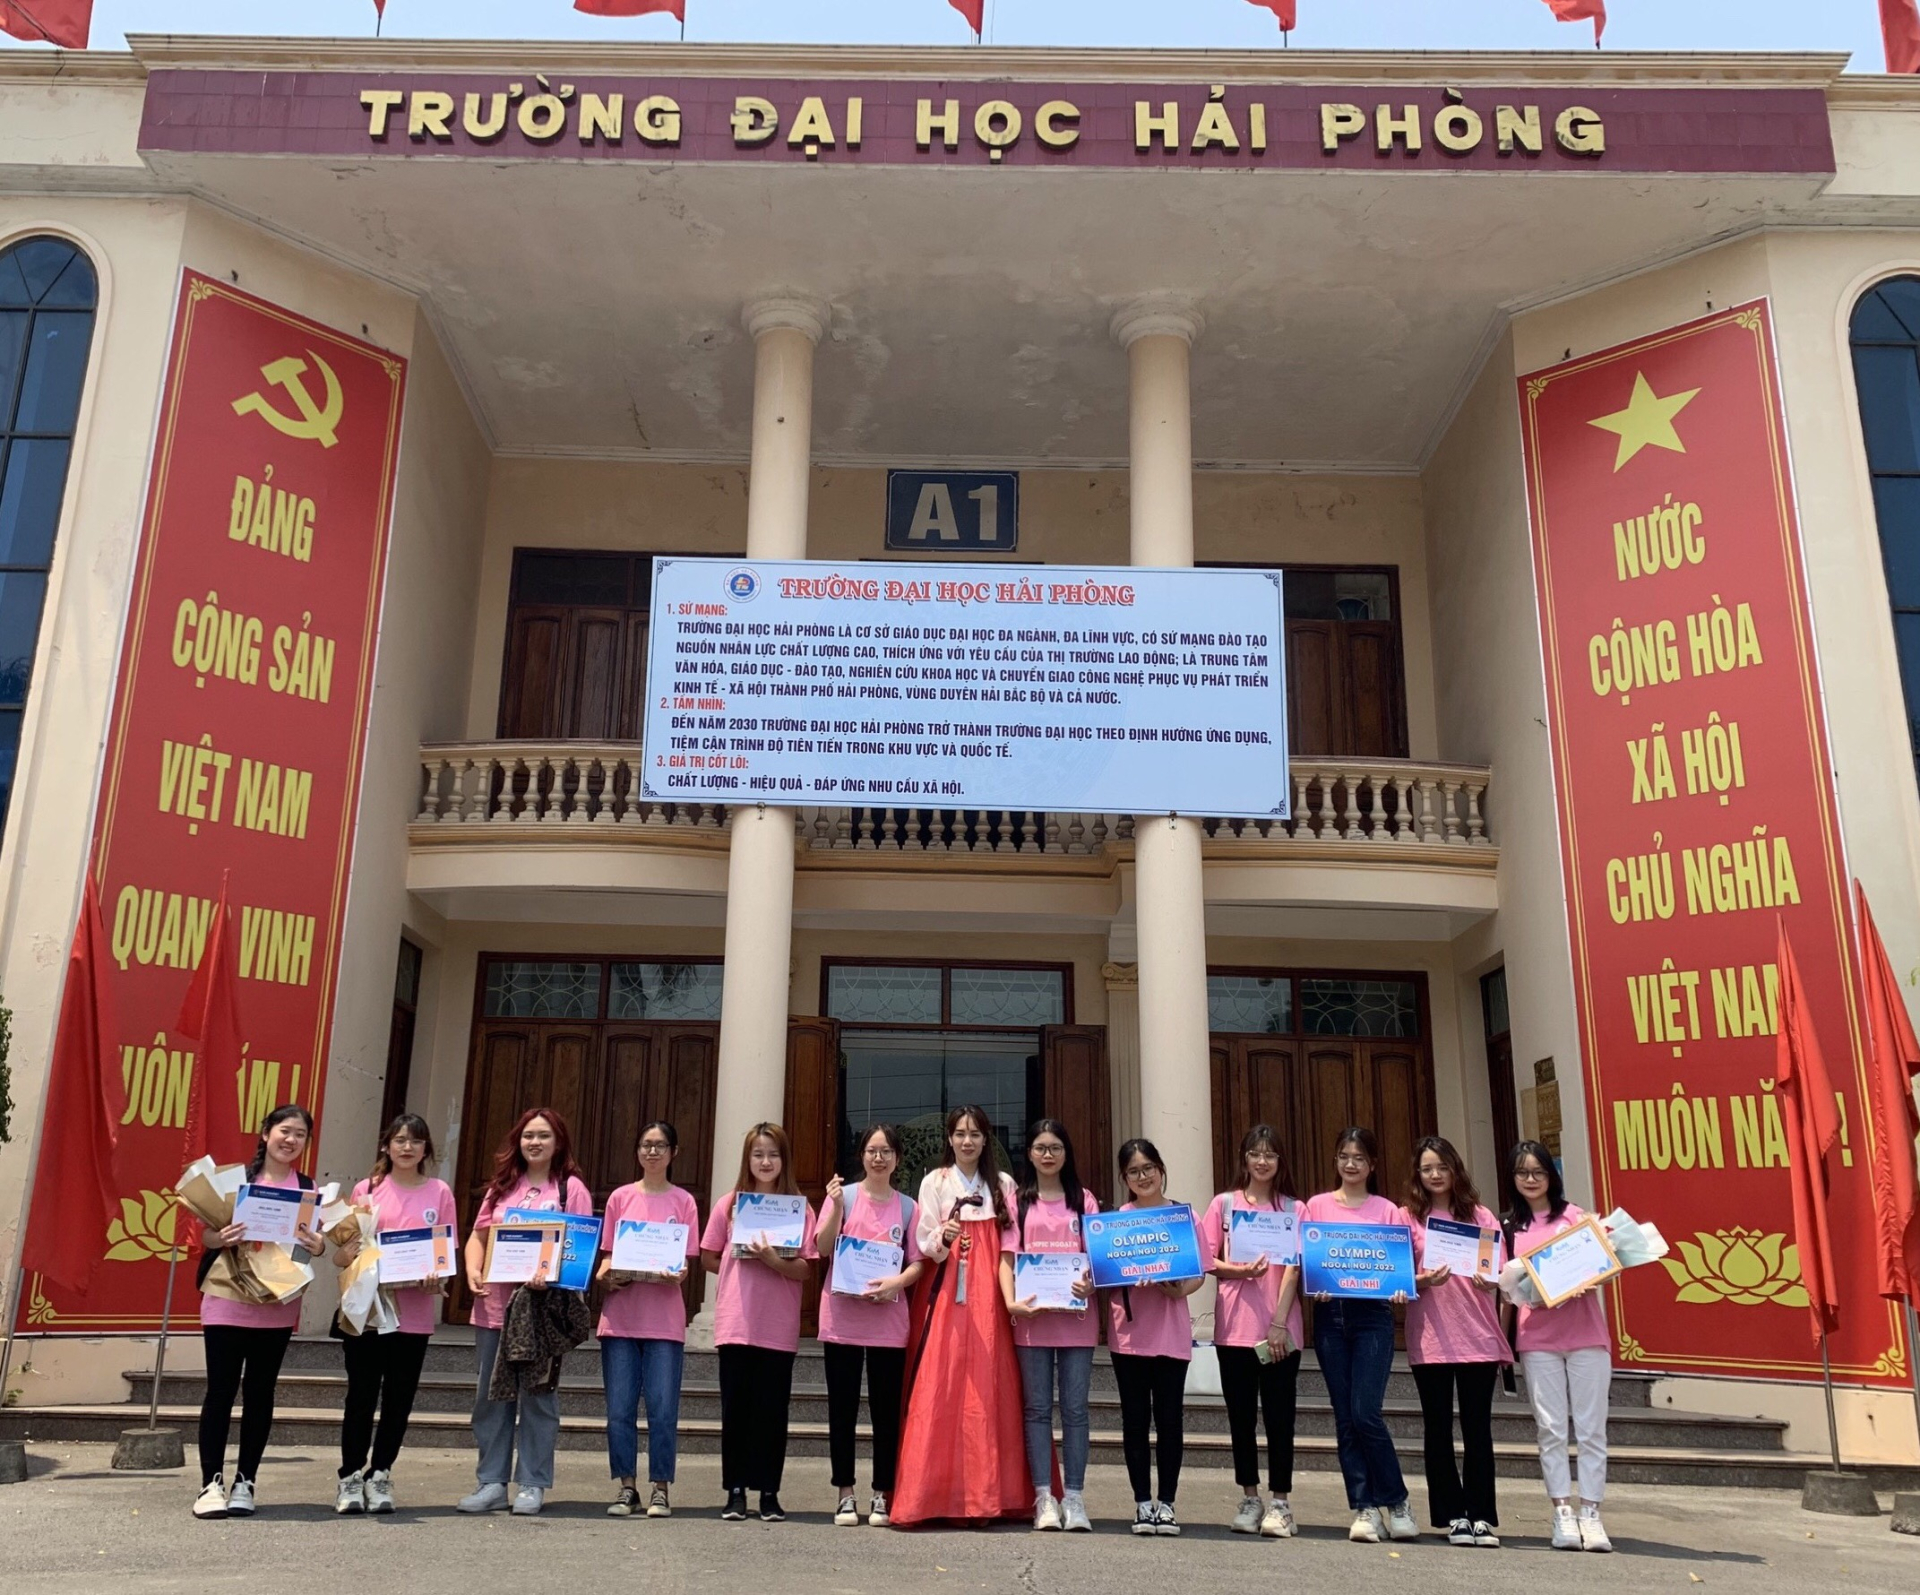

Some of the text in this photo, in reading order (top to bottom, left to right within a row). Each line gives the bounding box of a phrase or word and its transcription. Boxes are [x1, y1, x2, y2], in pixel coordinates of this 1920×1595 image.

[360, 72, 1606, 163] TRƯỜNG ĐẠI HỌC HẢI PHÒNG
[228, 463, 316, 562] ĐẢNG
[907, 482, 998, 541] A1
[1612, 492, 1706, 581] NƯỚC
[678, 602, 693, 615] SỨ
[776, 573, 879, 601] TRƯỜNG
[883, 580, 931, 606] ĐẠI
[935, 581, 990, 607] HỌC
[995, 576, 1043, 604] HẢI
[1047, 578, 1135, 606] PHÒNG
[172, 590, 335, 703] CỘNG SẢN
[675, 640, 716, 654] NGUỒN
[719, 640, 751, 655] NHÂN
[754, 642, 776, 658] LỰC
[779, 641, 809, 656] CHẤT
[812, 644, 849, 659] LƯỢNG
[882, 644, 915, 659] THÍCH
[919, 644, 943, 659] ỨNG
[946, 645, 964, 660] VỚI
[968, 646, 990, 661] YÊU
[994, 645, 1016, 661] CẦU
[1020, 646, 1044, 662] CỦA
[1047, 650, 1064, 665] THỊ
[1068, 648, 1114, 663] TRƯỜNG
[1118, 651, 1139, 664] LAO
[1182, 650, 1196, 665] LÀ
[1200, 653, 1239, 666] TRUNG
[1242, 652, 1268, 667] TÂM
[677, 621, 722, 634] TRƯỜNG
[724, 622, 744, 637] ĐẠI
[747, 623, 770, 637] HỌC
[773, 620, 792, 636] HẢI
[796, 622, 835, 637] PHÒNG
[838, 623, 852, 637] LÀ
[855, 625, 871, 638] CƠ
[874, 623, 890, 638] SỞ
[892, 624, 919, 639] GIÁO
[923, 627, 946, 642] DỤC
[949, 628, 968, 642] ĐẠI
[971, 628, 994, 643] HỌC
[997, 629, 1013, 641] ĐA
[1063, 630, 1079, 643] ĐA
[1082, 629, 1108, 643] LĨNH
[1141, 629, 1157, 644] CÓ
[1160, 629, 1178, 645] SỨ
[1180, 633, 1214, 647] MẠNG
[1218, 631, 1242, 646] ĐÀO
[1245, 634, 1267, 649] TẠO
[1588, 593, 1763, 706] CỘNG HÒA
[675, 659, 698, 673] VĂN
[730, 662, 757, 675] GIÁO
[760, 663, 783, 677] DỤC
[794, 662, 817, 676] ĐÀO
[848, 663, 891, 678] NGHIÊN
[895, 664, 918, 679] CỨU
[921, 667, 952, 680] KHOA
[955, 668, 978, 683] HỌC
[981, 666, 996, 681] VÀ
[999, 665, 1044, 682] CHUYỂN
[1048, 670, 1074, 683] GIAO
[1078, 668, 1110, 683] CÔNG
[1113, 669, 1144, 687] NGHỆ
[1148, 672, 1179, 688] PHỤC
[1182, 673, 1197, 688] VỤ
[1201, 671, 1231, 686] PHÁT
[1234, 670, 1268, 687] TRIỂN
[671, 712, 695, 728] ĐẾN
[698, 715, 726, 729] NĂM
[728, 717, 757, 730] 2030
[760, 716, 807, 731] TRƯỜNG
[810, 720, 830, 734] ĐẠI
[833, 720, 857, 735] HỌC
[860, 717, 880, 733] HẢI
[883, 719, 924, 735] PHÒNG
[927, 719, 950, 735] TRỞ
[952, 721, 991, 736] THÀNH
[994, 722, 1041, 738] TRƯỜNG
[1044, 726, 1064, 741] ĐẠI
[1068, 726, 1092, 741] HỌC
[1095, 727, 1125, 740] THEO
[1128, 728, 1157, 743] ĐỊNH
[1161, 726, 1202, 742] HƯỚNG
[1206, 726, 1231, 742] ỨNG
[158, 733, 313, 839] VIỆT NAM
[667, 770, 698, 787] CHẤT
[700, 774, 738, 790] LƯỢNG
[749, 774, 776, 792] HIỆU
[779, 773, 802, 791] QUẢ
[813, 776, 837, 791] ĐÁP
[840, 776, 865, 792] ỨNG
[868, 779, 892, 793] NHU
[895, 776, 919, 793] CẦU
[922, 779, 938, 793] XÃ
[689, 755, 705, 770] TRỊ
[708, 753, 727, 768] CỐT
[1626, 711, 1745, 806] XÃ HỘI
[1606, 824, 1801, 924] CHỦ NGHĨA
[112, 885, 316, 986] QUAN VINH
[1626, 957, 1701, 1058] VIỆT
[120, 1031, 194, 1128] UÔN
[1613, 1082, 1725, 1171] MUÔN
[1730, 1077, 1792, 1168] NĂ
[1113, 1231, 1170, 1248] OLYMPIC
[1159, 1244, 1180, 1254] 2022
[1328, 1247, 1386, 1260] OLYMPIC
[1374, 1263, 1395, 1272] 2022
